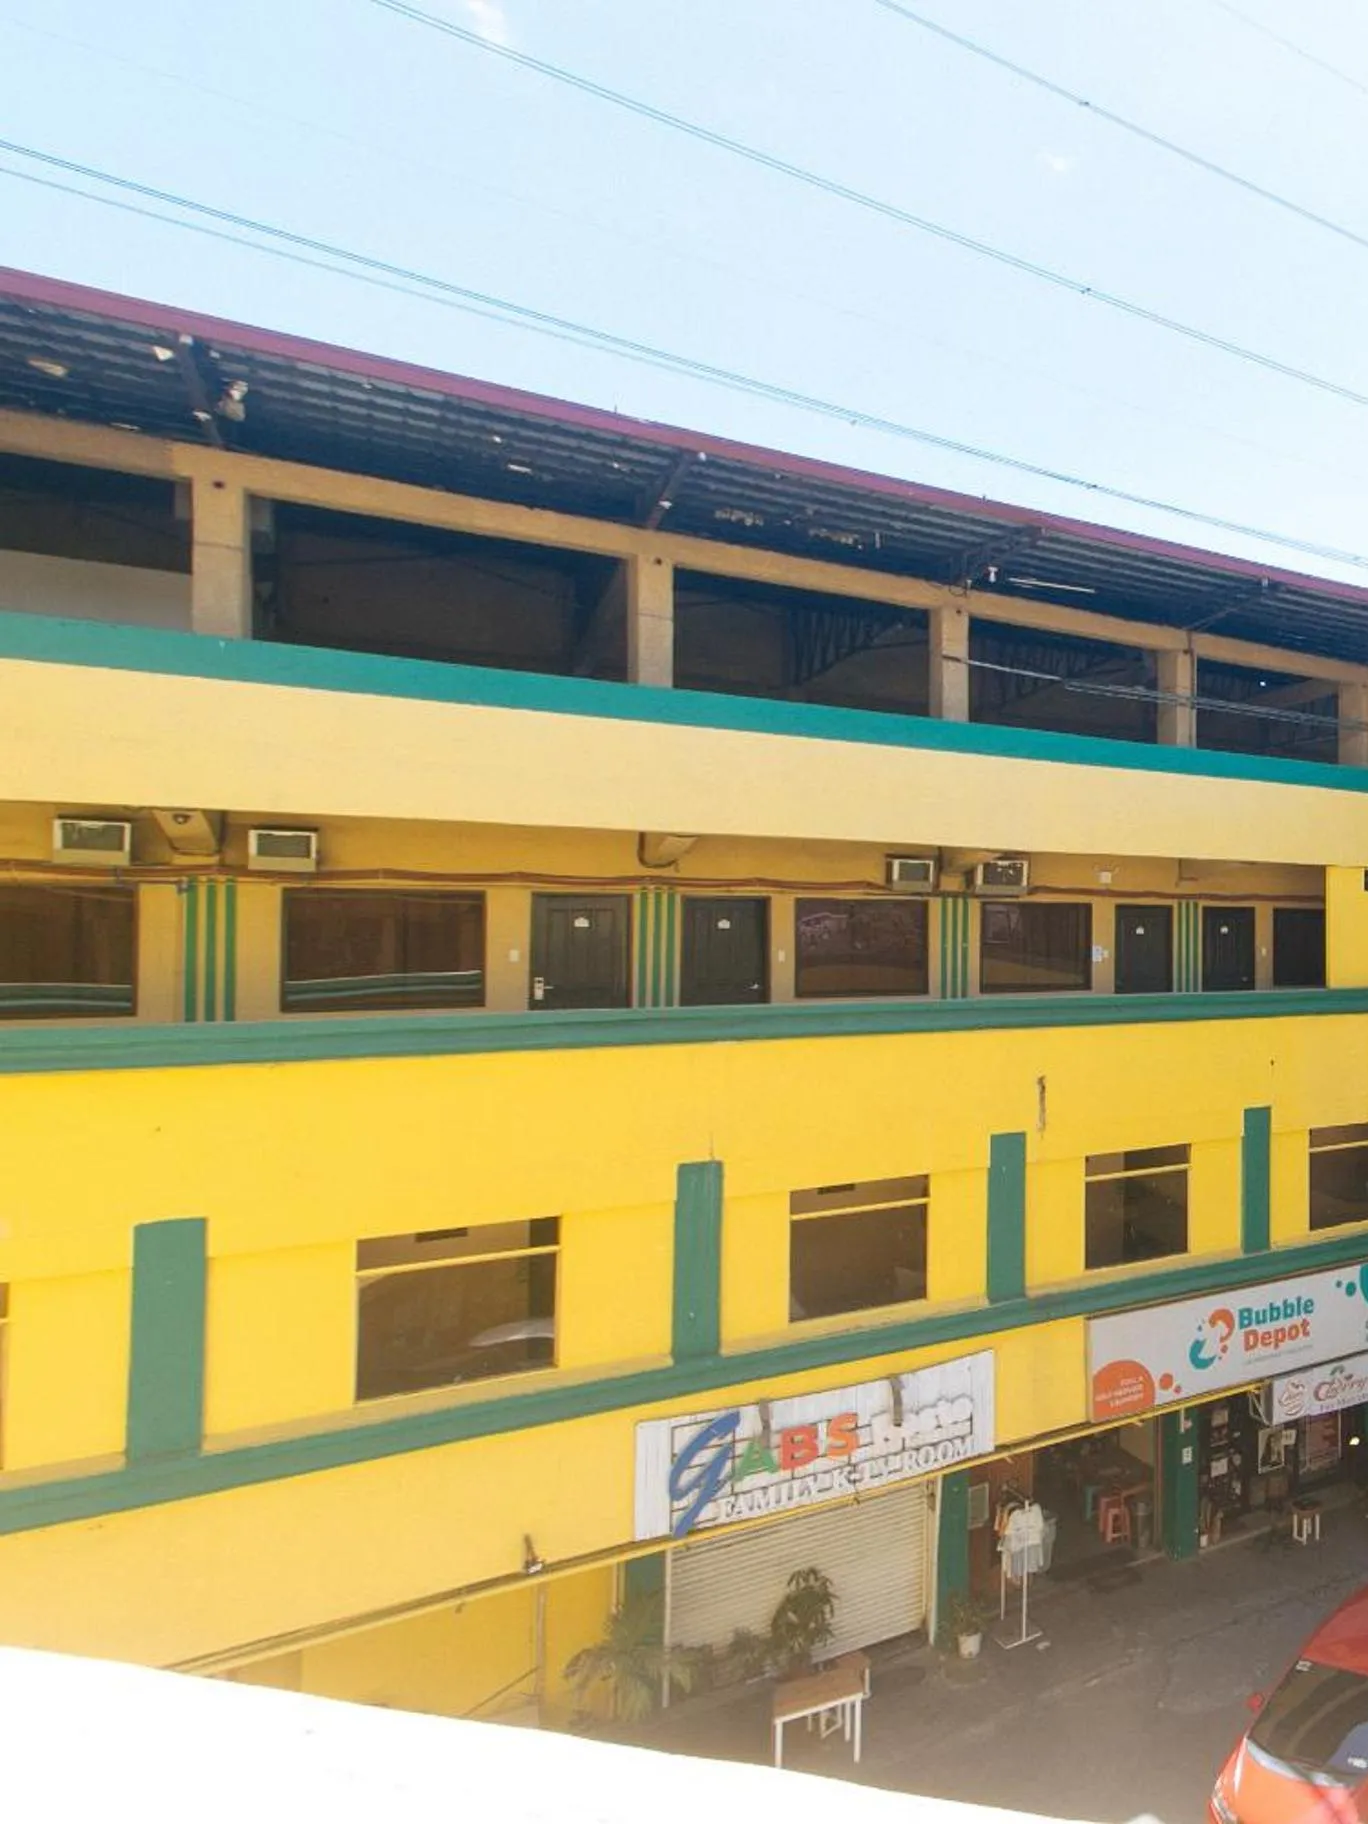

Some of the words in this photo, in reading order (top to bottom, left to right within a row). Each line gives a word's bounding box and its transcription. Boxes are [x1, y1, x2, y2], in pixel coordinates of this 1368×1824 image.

[1238, 1296, 1314, 1330] Bubble
[1243, 1318, 1311, 1351] Depot
[717, 1474, 822, 1521] FAMILY
[901, 1436, 976, 1476] ROOM
